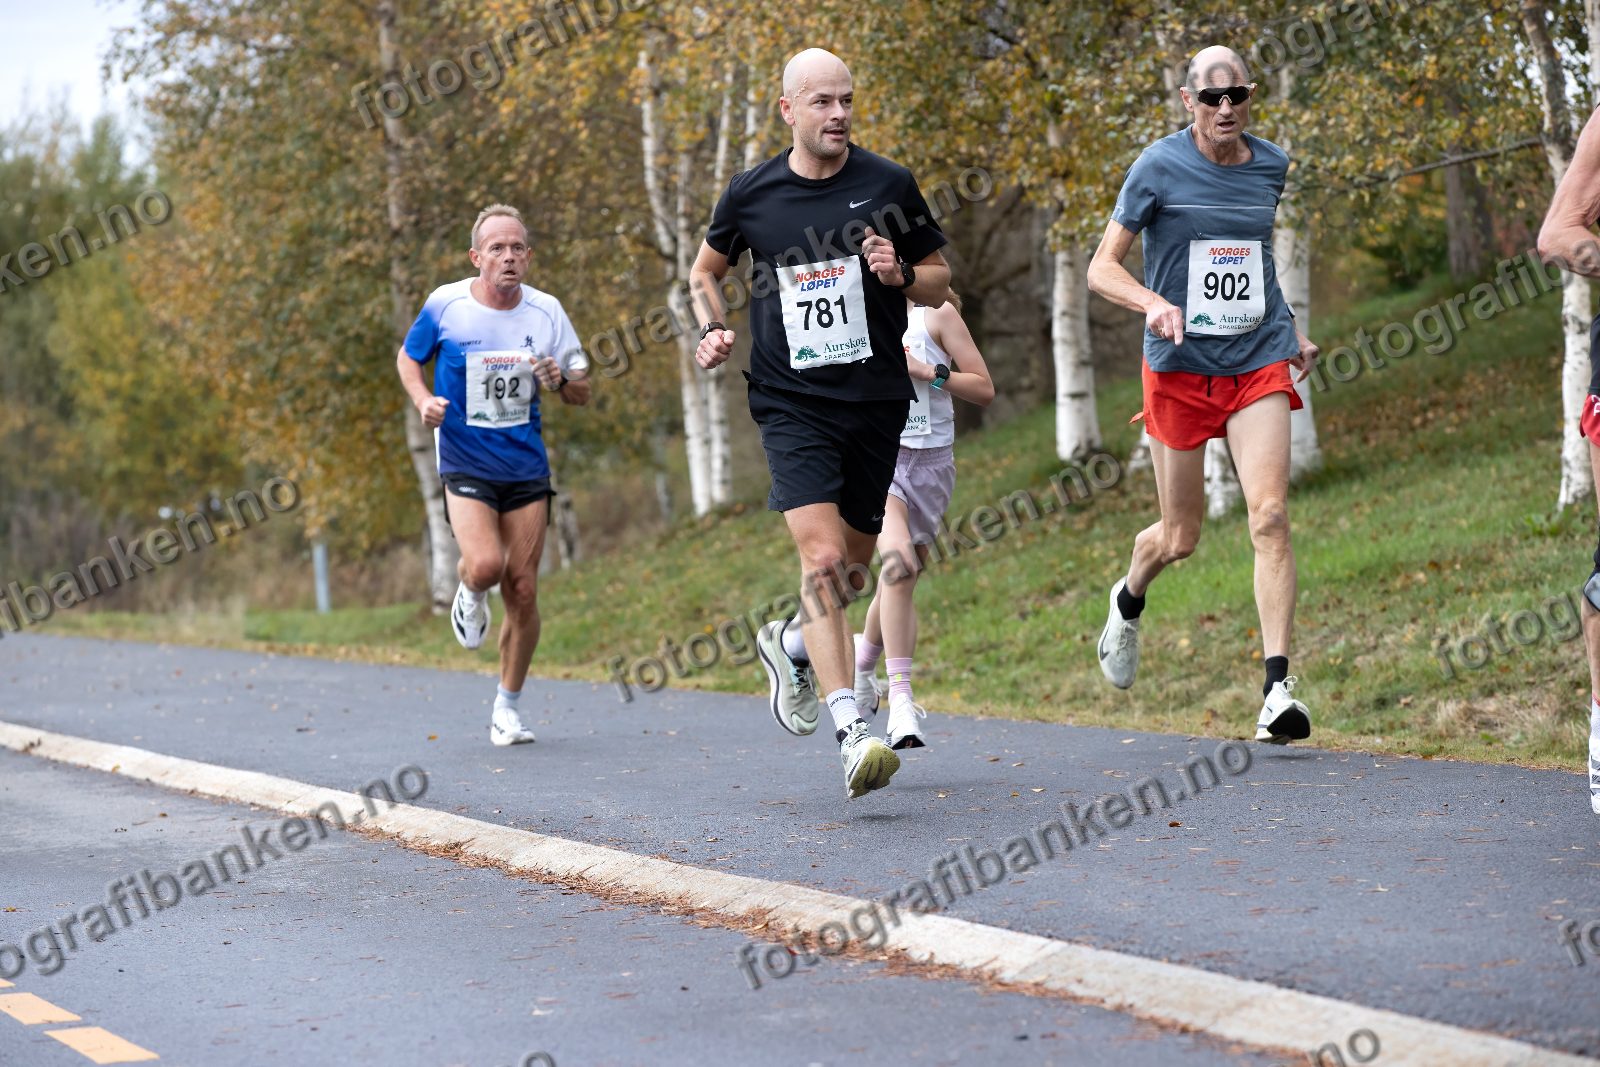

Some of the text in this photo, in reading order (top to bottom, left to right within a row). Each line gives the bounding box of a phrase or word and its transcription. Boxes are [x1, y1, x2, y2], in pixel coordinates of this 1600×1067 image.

[1208, 247, 1251, 256] NORGES
[1212, 256, 1245, 265] LØPET
[795, 265, 846, 283] NORGES
[800, 276, 839, 292] LØPET
[1203, 271, 1251, 301] 902
[796, 294, 849, 331] 781
[1219, 313, 1261, 325] Aurskog
[823, 336, 868, 354] Aurskog
[482, 356, 522, 365] NORGES
[485, 363, 516, 372] LØPET
[481, 375, 521, 400] 192
